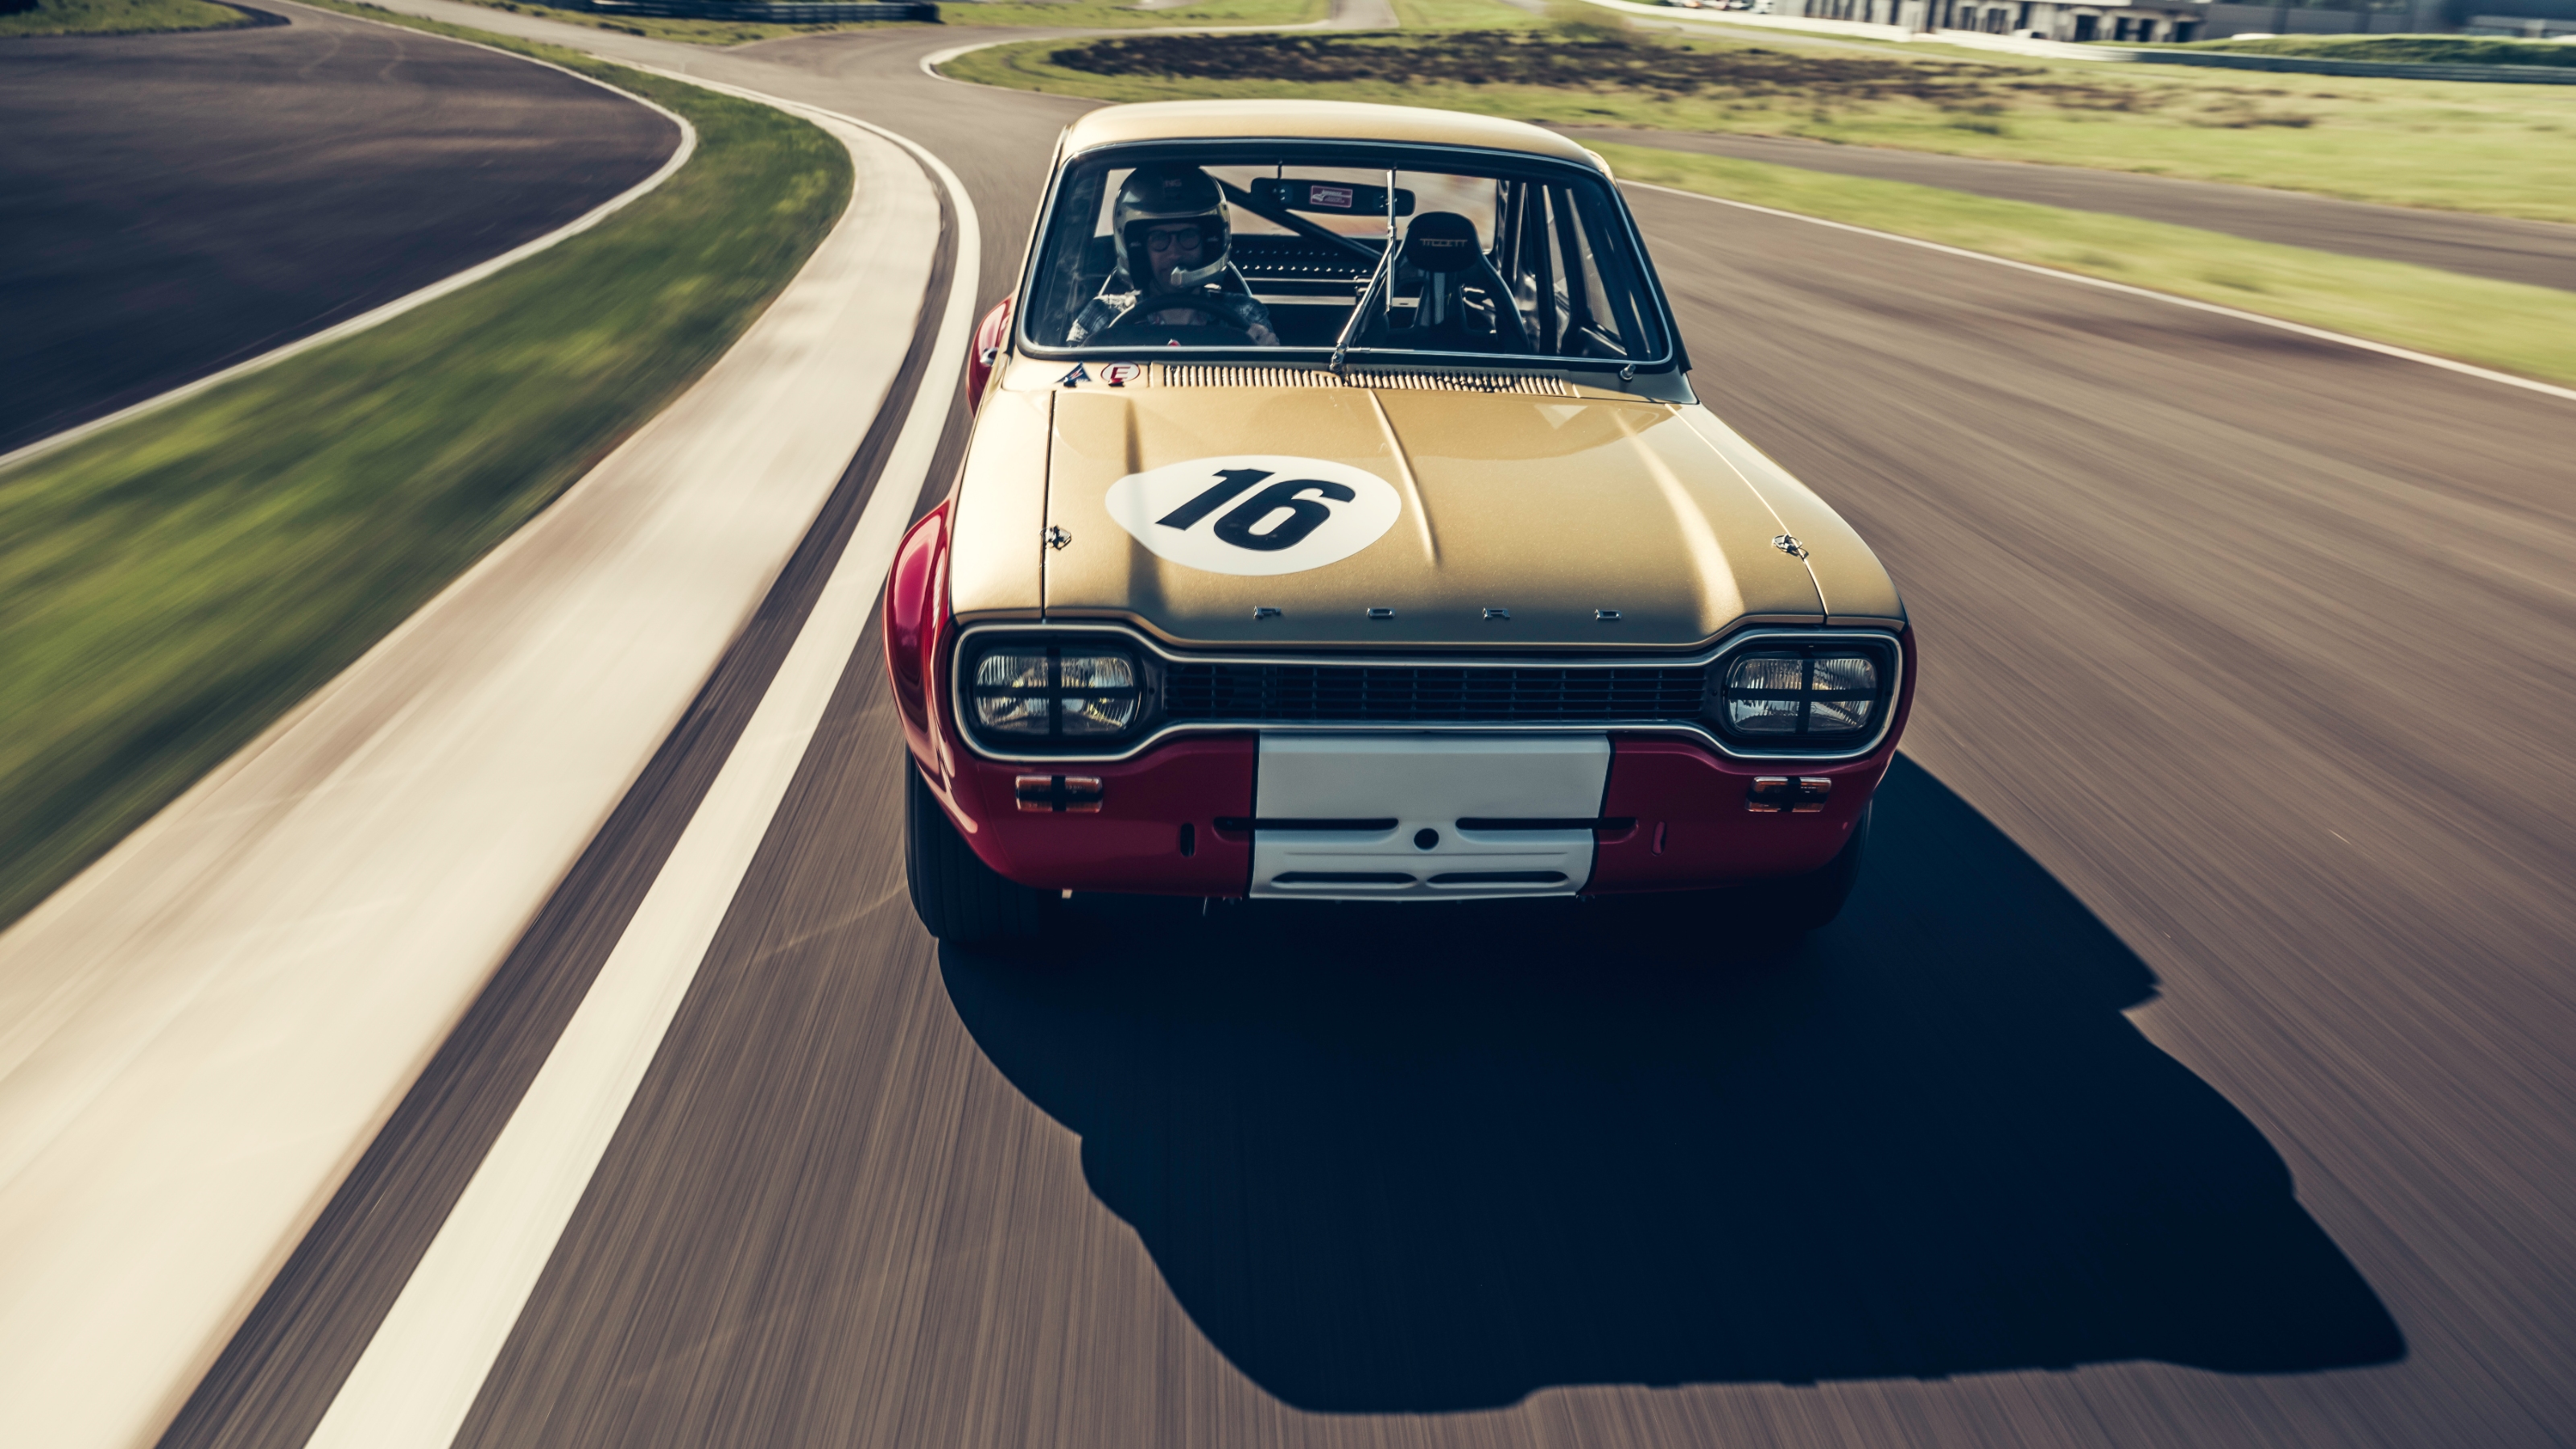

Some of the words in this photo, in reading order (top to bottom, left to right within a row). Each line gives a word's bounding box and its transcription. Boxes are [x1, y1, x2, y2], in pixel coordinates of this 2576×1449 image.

[1111, 366, 1131, 380] E
[1154, 468, 1356, 551] 16
[1253, 605, 1622, 621] FORD
